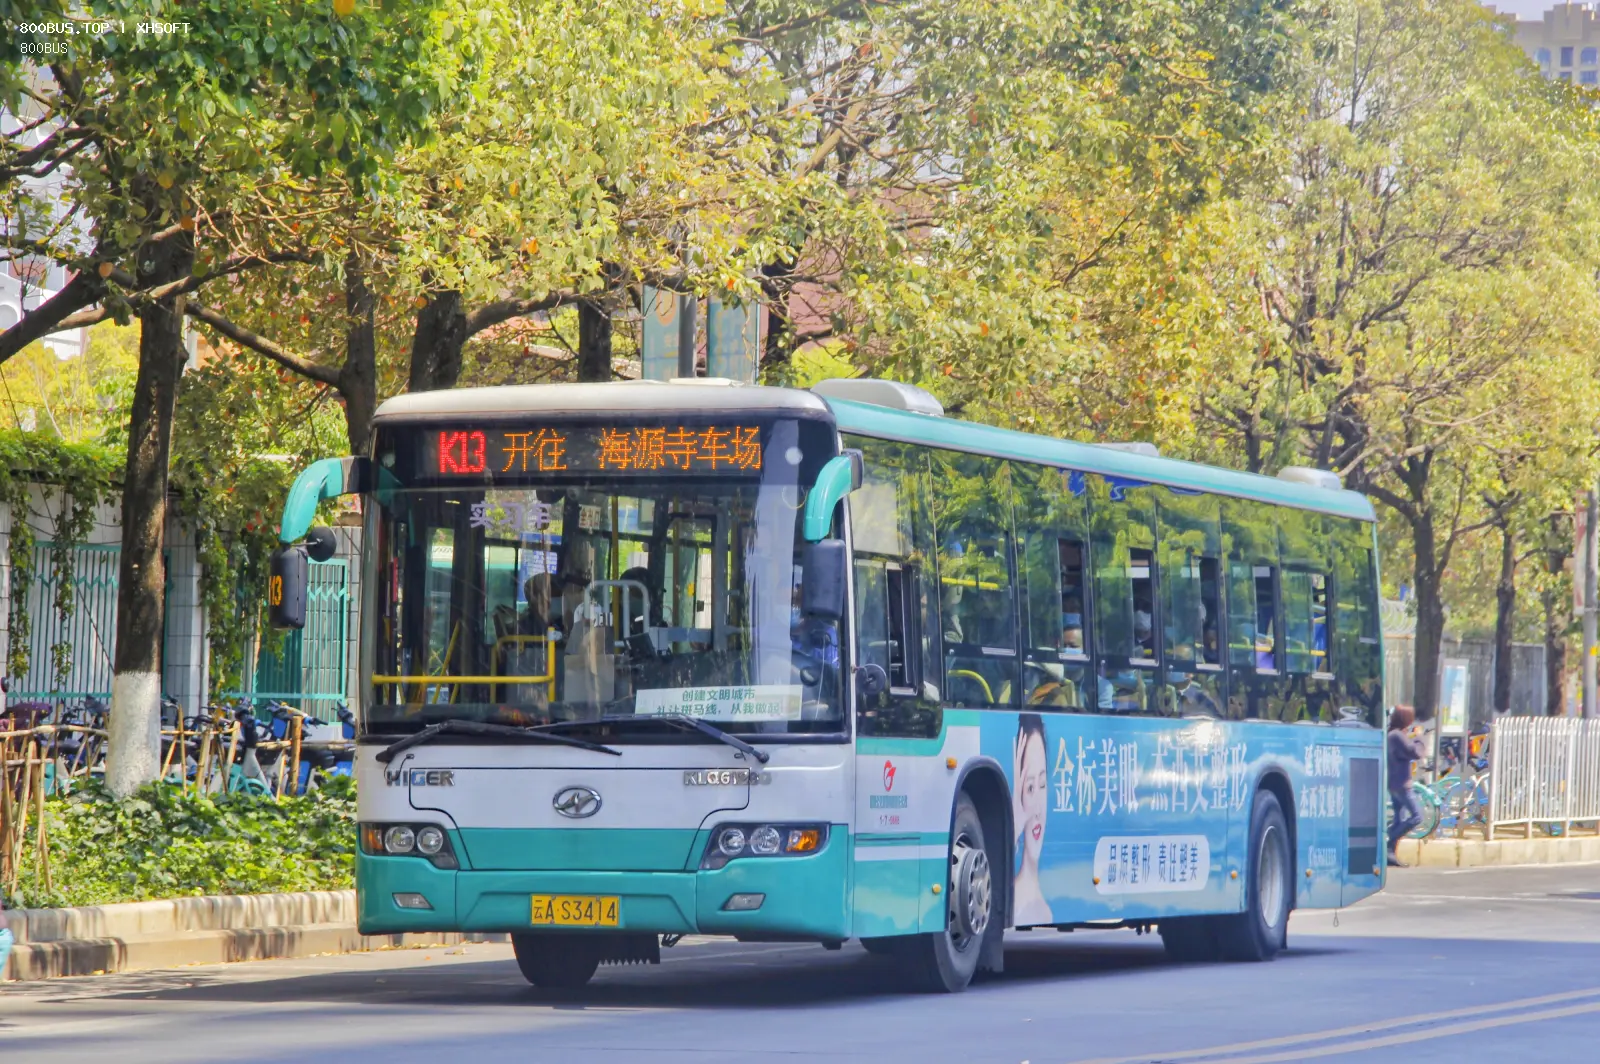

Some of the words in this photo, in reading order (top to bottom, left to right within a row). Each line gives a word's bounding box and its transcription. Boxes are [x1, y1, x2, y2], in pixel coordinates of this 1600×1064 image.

[438, 431, 486, 473] K13
[502, 428, 567, 472] 开往
[599, 426, 762, 470] 海源寺车场
[682, 688, 756, 702] 创建文明城市
[386, 769, 455, 787] HIGER
[1052, 735, 1139, 817] 金标美眼
[1107, 842, 1151, 885] 品质整形
